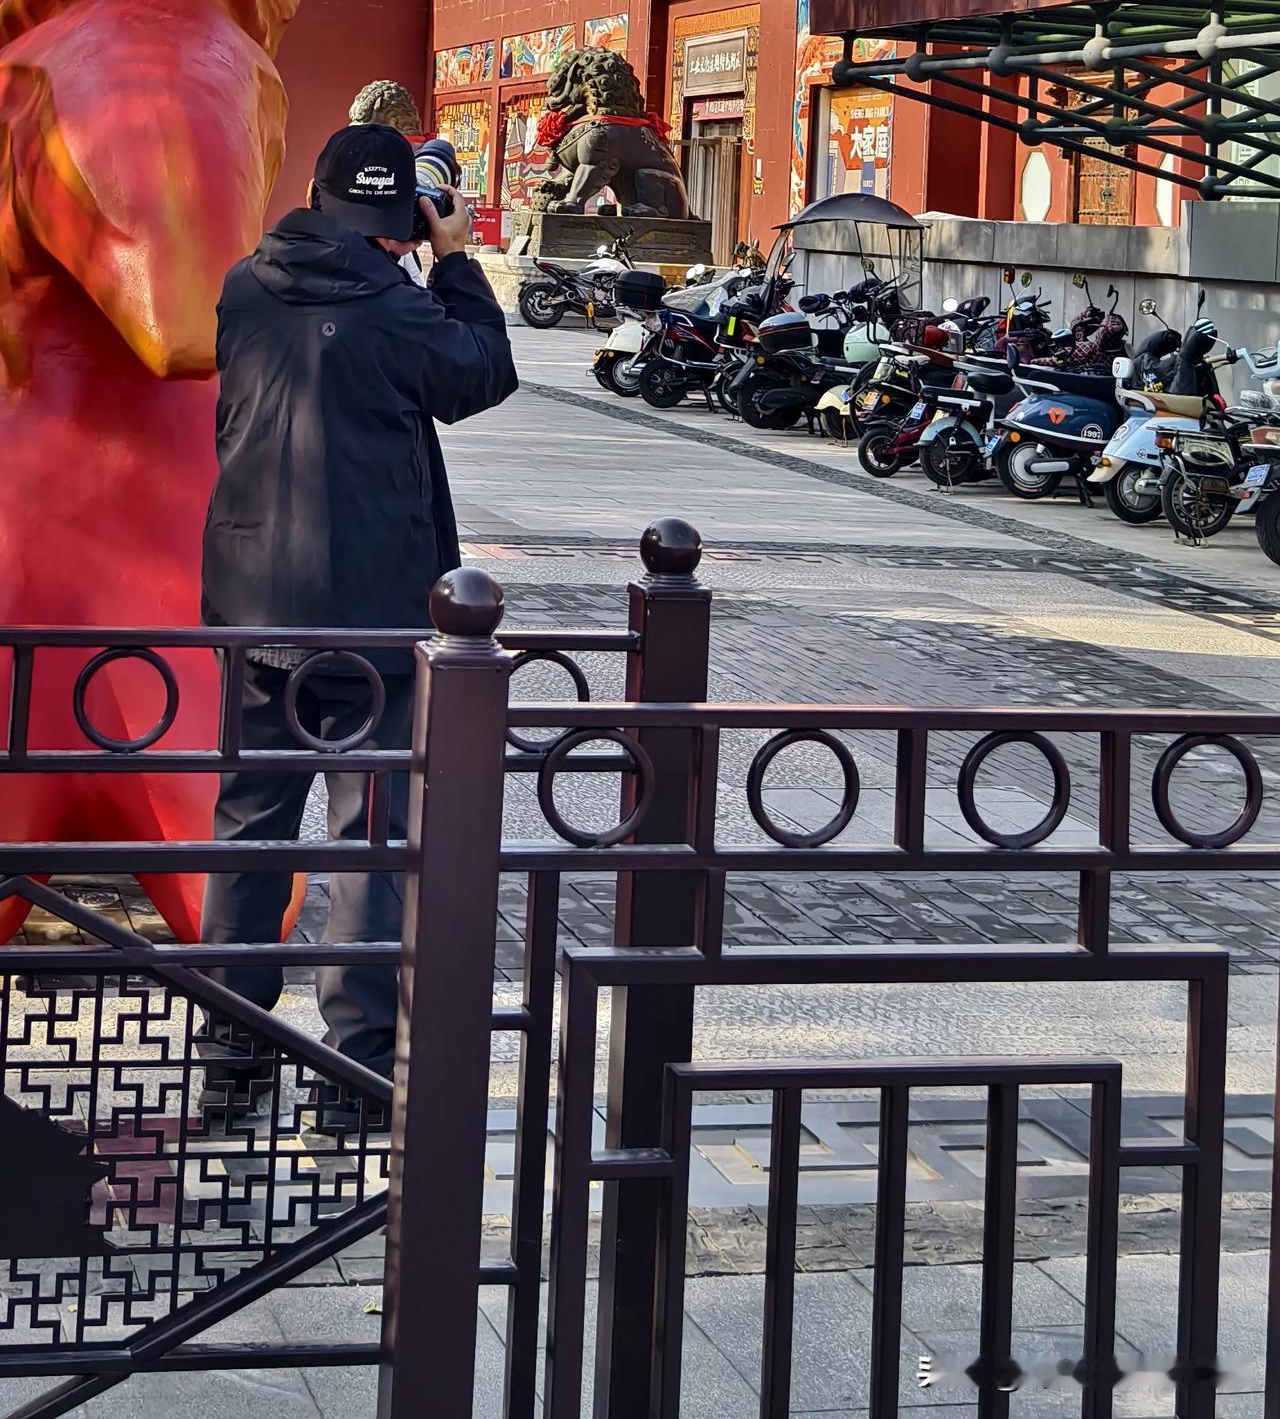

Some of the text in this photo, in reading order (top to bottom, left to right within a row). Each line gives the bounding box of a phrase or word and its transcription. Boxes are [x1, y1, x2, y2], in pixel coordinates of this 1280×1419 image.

[850, 125, 889, 159] 大家庭
[1083, 429, 1101, 439] 1997
